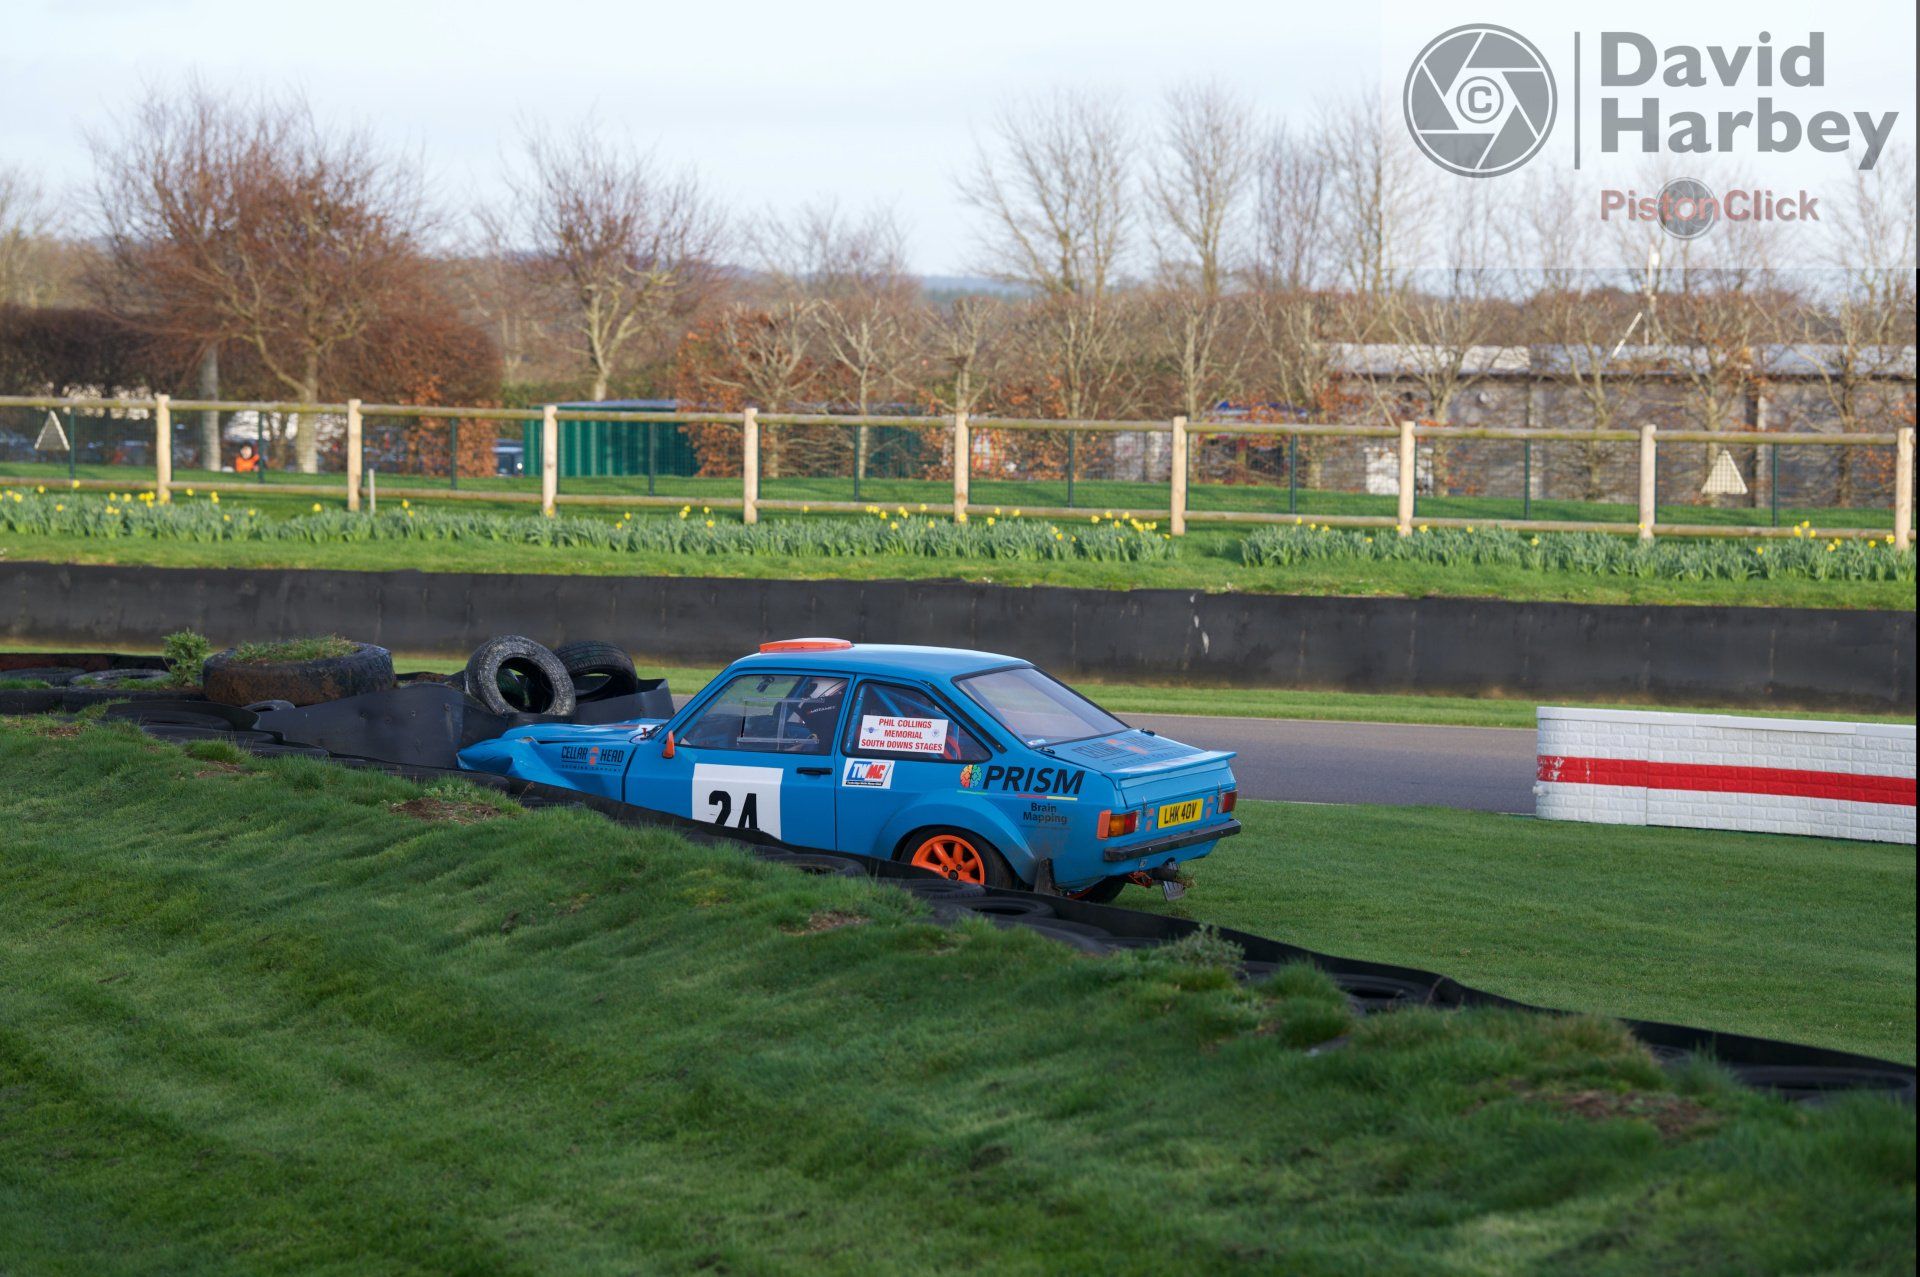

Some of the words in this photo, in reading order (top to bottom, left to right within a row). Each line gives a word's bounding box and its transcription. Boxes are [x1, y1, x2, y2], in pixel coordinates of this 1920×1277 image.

[879, 718, 895, 727] PHIL
[898, 719, 932, 729] COLLINGS
[884, 730, 923, 739] MEMORIAL
[861, 739, 885, 748] SOUTH
[887, 740, 913, 750] DOWNS
[915, 742, 943, 751] STAGES
[561, 745, 589, 760] CELLAR
[600, 748, 625, 763] HEAD
[982, 765, 1086, 795] PRISM
[1031, 803, 1057, 812] Brain
[1023, 811, 1068, 825] Mapping
[1164, 805, 1180, 824] LHK
